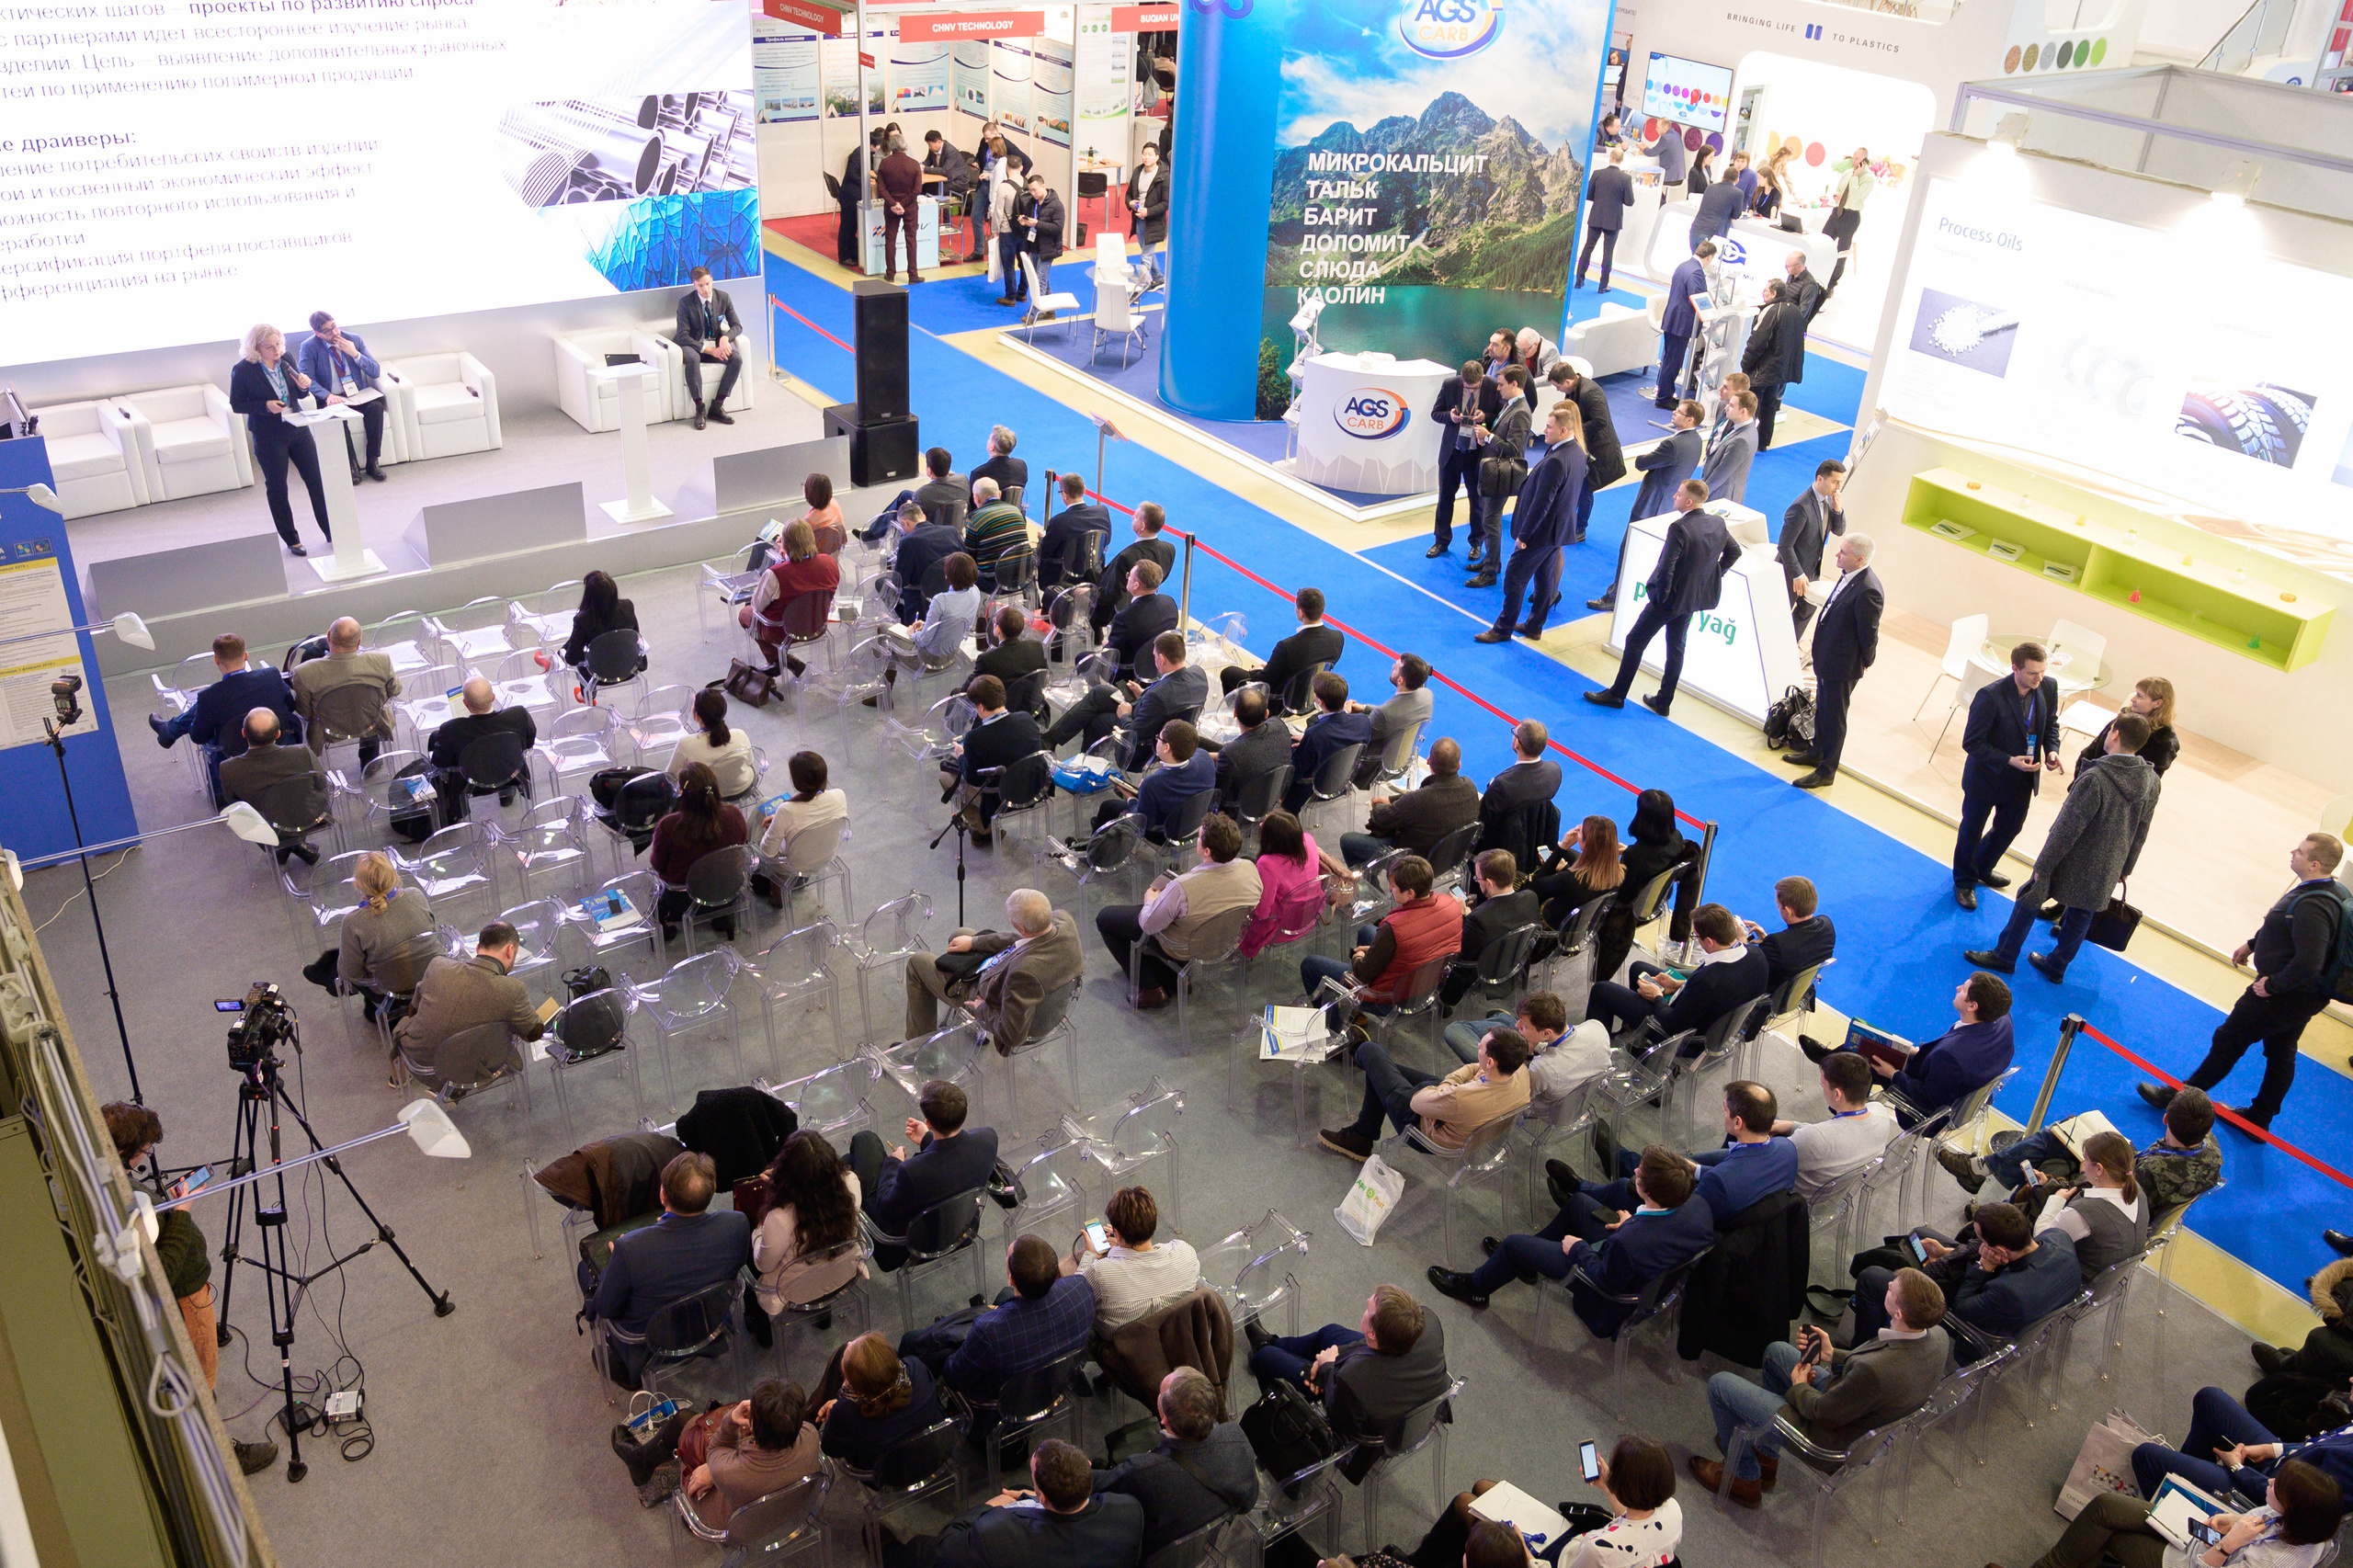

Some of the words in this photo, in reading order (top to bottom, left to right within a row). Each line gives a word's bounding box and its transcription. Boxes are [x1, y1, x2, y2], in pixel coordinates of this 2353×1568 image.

[106, 5, 165, 17] шагов
[189, 1, 275, 17] проекты
[282, 0, 304, 11] по
[779, 3, 792, 14] CHNV
[793, 6, 824, 23] TECHNOLOGY
[1140, 14, 1168, 23] SUQIAN
[1415, 0, 1476, 23] AGS
[15, 30, 136, 50] партнерами
[143, 29, 185, 43] идет
[194, 24, 322, 40] всестороннее
[329, 21, 408, 37] изучение
[415, 18, 466, 33] рынка
[932, 23, 957, 32] CHNV
[957, 20, 1014, 31] TECHNOLOGY
[1418, 26, 1469, 41] CARB
[1726, 12, 1772, 28] BRINGING
[1776, 21, 1797, 33] LIFE
[1832, 33, 1845, 42] TO
[1849, 36, 1900, 53] PLASTICS
[83, 54, 133, 73] Цель
[158, 51, 262, 65] выявление
[269, 44, 417, 62] дополнительных
[424, 40, 506, 57] рыночных
[41, 85, 64, 97] по
[73, 79, 196, 98] применению
[203, 73, 316, 88] полимерной
[22, 132, 137, 154] драйверы:
[61, 152, 224, 174] потребительских
[1308, 153, 1488, 176] МИКРОКАЛЬЦИТ
[31, 188, 43, 199] и
[306, 163, 370, 180] эффект
[1306, 180, 1379, 199] ТАЛЬК
[0, 210, 85, 226] ожность
[92, 200, 198, 218] повторного
[205, 189, 339, 209] использования
[346, 187, 355, 198] и
[1303, 207, 1378, 225] БАРИТ
[1300, 234, 1411, 255] ДОЛОМИТ
[1938, 217, 1993, 244] Process
[1997, 232, 2023, 251] Oils
[0, 253, 133, 278] ерсификация
[141, 244, 231, 263] портфеля
[238, 233, 352, 252] поставщиков
[154, 273, 176, 283] на
[183, 267, 236, 284] рынке
[1299, 261, 1381, 281] СЛЮДА
[1297, 287, 1385, 304] КАОЛИН
[1344, 397, 1389, 418] AGS
[1347, 416, 1384, 429] CARB
